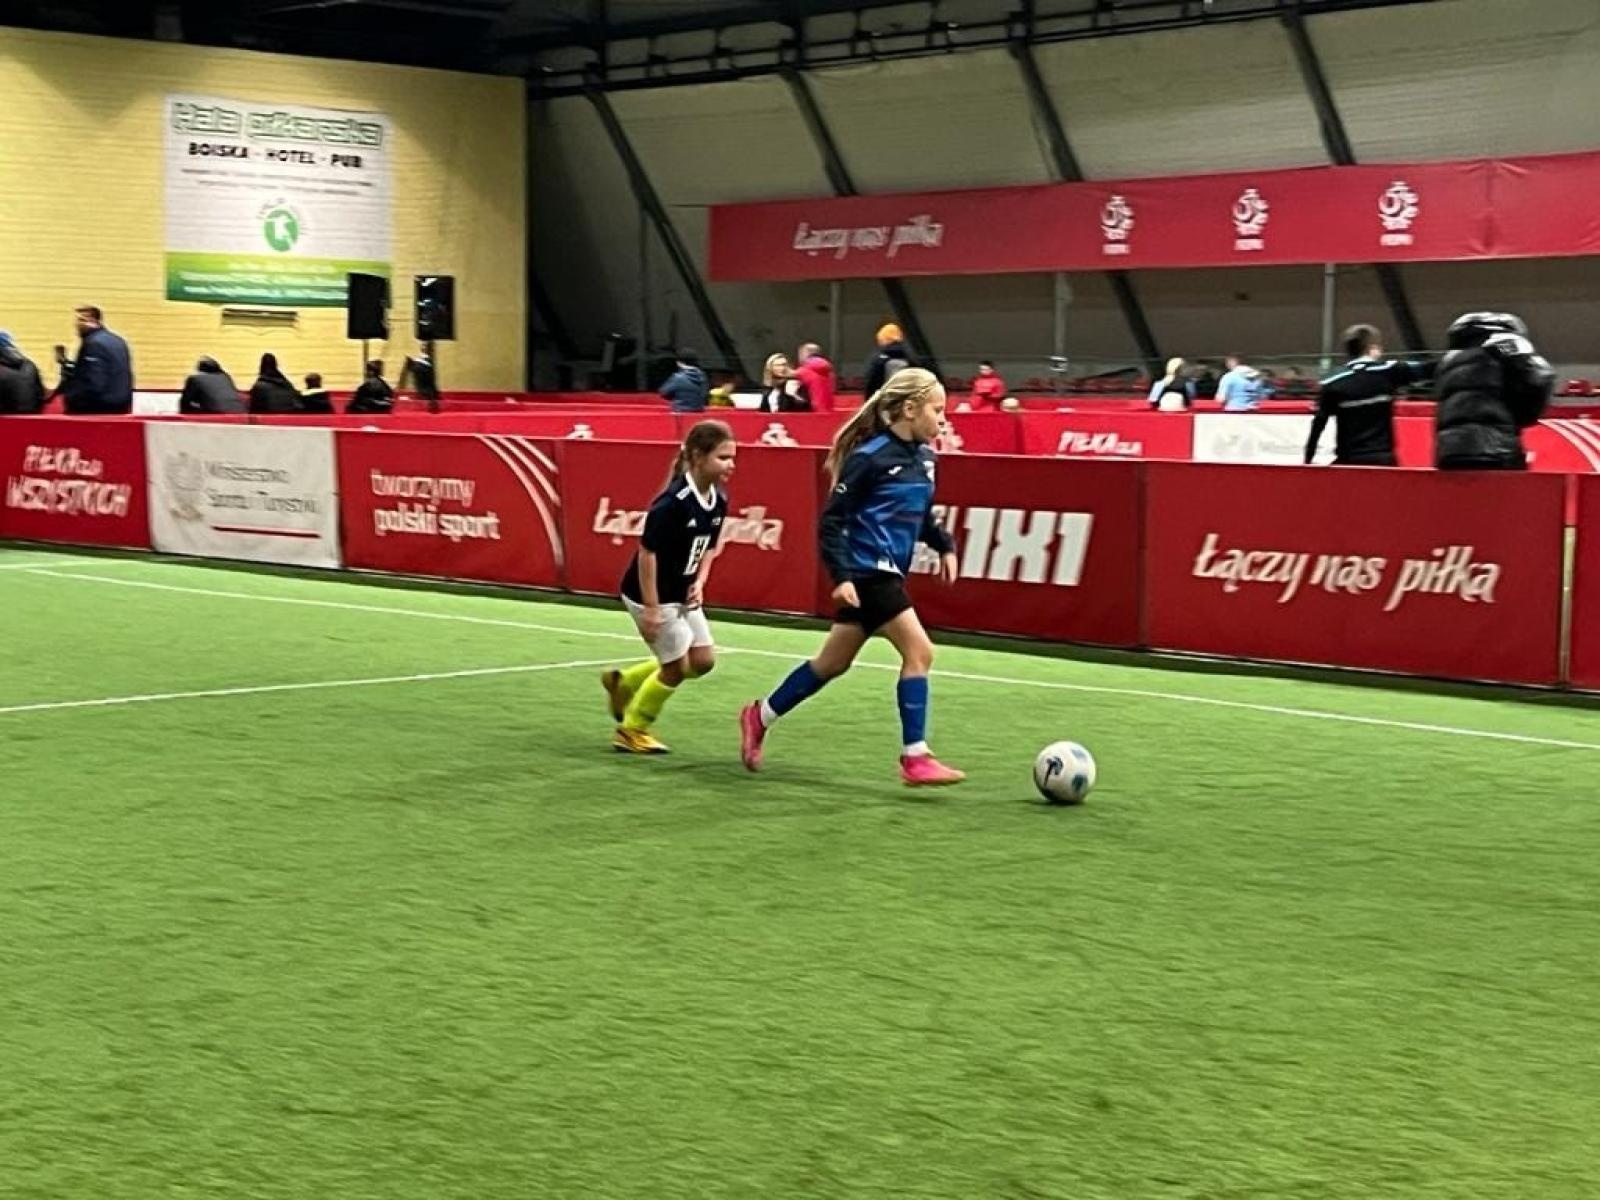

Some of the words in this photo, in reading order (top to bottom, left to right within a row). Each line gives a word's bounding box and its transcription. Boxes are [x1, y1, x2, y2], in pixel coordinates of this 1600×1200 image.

[330, 153, 364, 168] PUB
[371, 468, 476, 507] tworzymy
[374, 502, 438, 536] polski
[439, 511, 501, 542] sport
[1192, 533, 1310, 603] Łączy
[1309, 554, 1387, 594] nas
[1383, 545, 1500, 611] piłka
